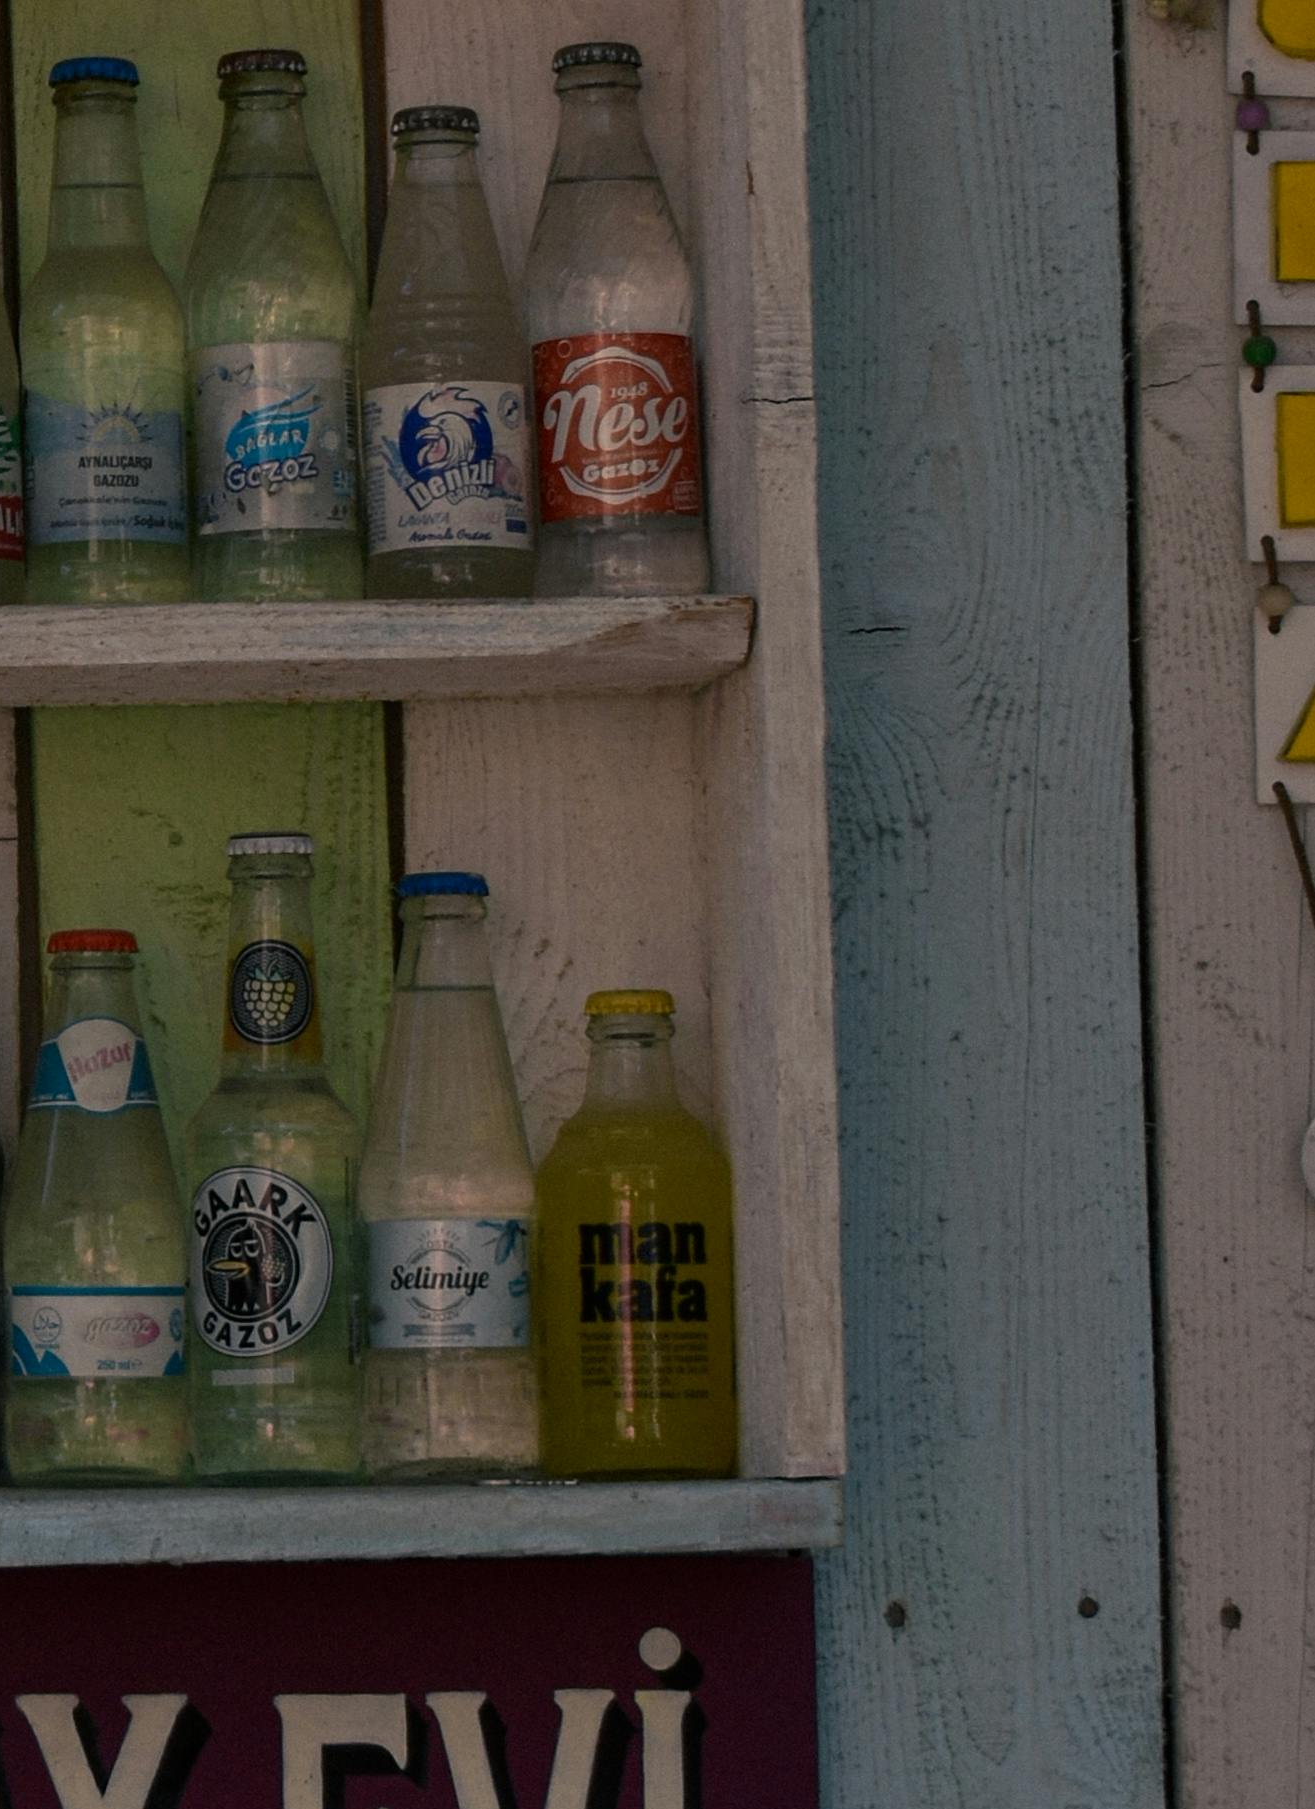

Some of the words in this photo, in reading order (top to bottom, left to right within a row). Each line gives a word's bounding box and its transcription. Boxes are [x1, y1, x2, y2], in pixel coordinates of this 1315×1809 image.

[610, 381, 650, 400] 1948
[94, 474, 139, 488] GAZOZU
[406, 458, 496, 511] Denizli
[195, 1179, 317, 1238] GAARK
[578, 1222, 706, 1265] man
[390, 1265, 490, 1296] Selimiye
[579, 1264, 708, 1322] kafa
[204, 1309, 302, 1348] GAZOZ
